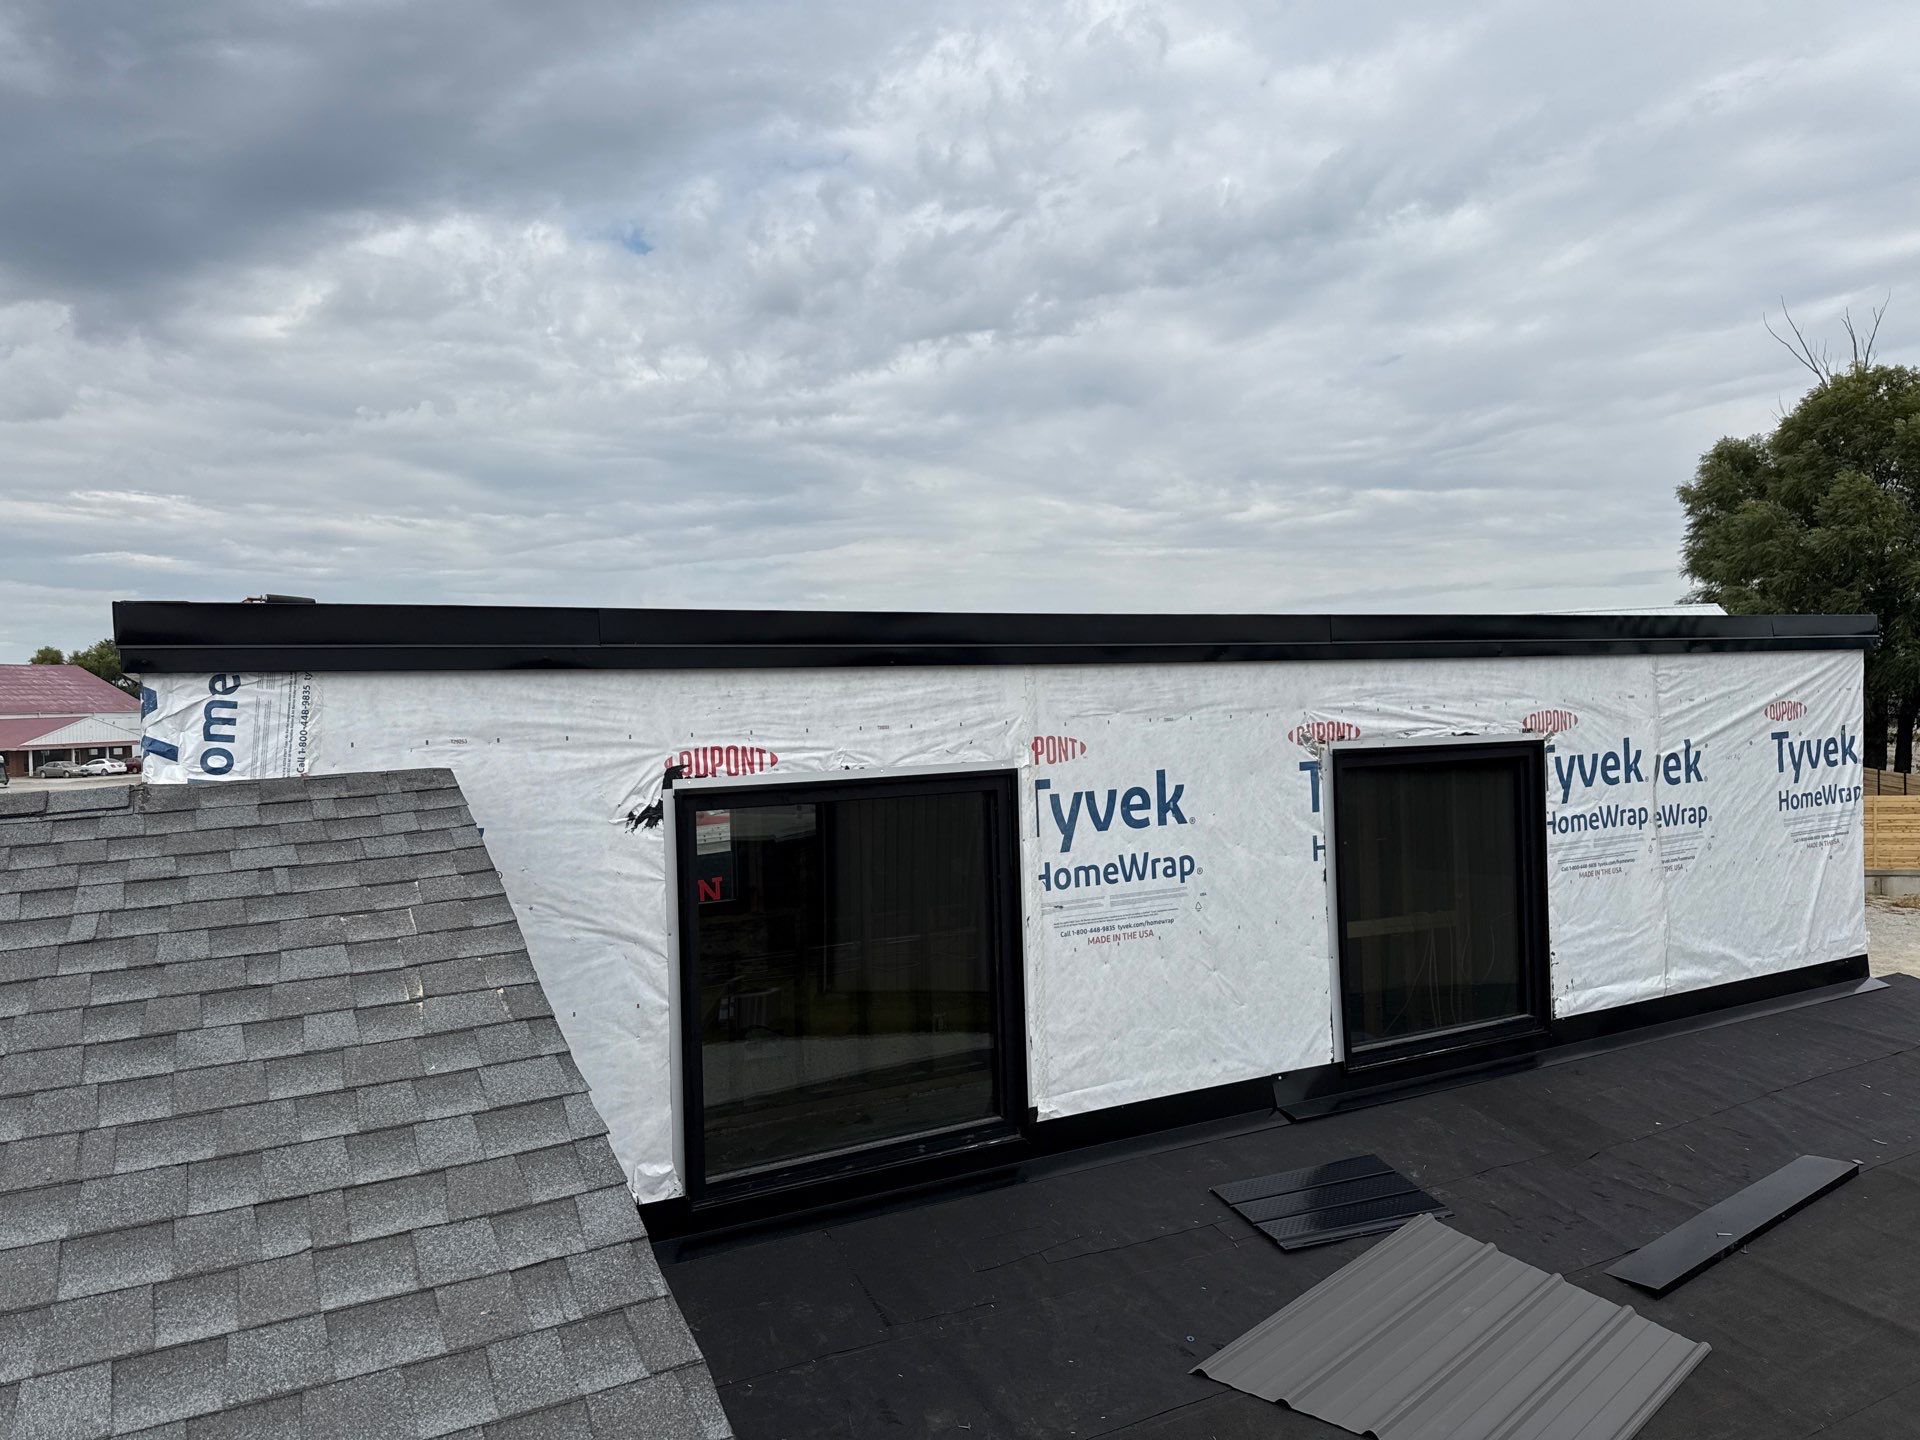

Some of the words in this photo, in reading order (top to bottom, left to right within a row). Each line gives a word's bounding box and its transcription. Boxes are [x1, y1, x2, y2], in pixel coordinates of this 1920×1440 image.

[1529, 709, 1573, 734] DUPONT
[1769, 700, 1803, 721] DUPONT
[200, 673, 240, 784] ome
[679, 745, 766, 777] DUPONT
[1771, 725, 1858, 783] Tyvek
[1779, 784, 1861, 811] HomeWrap
[1579, 870, 1594, 879] MADE
[1595, 869, 1601, 877] IN
[1601, 868, 1611, 876] THE
[1612, 866, 1622, 874] USA
[1060, 930, 1071, 938] Call
[1072, 925, 1116, 936] 1-800-448-9835
[1117, 918, 1175, 931] tyvek.com/homewrap
[1087, 935, 1111, 945] MADE
[1112, 933, 1121, 942] IN
[1122, 931, 1138, 941] THE
[1139, 929, 1155, 939] USA
